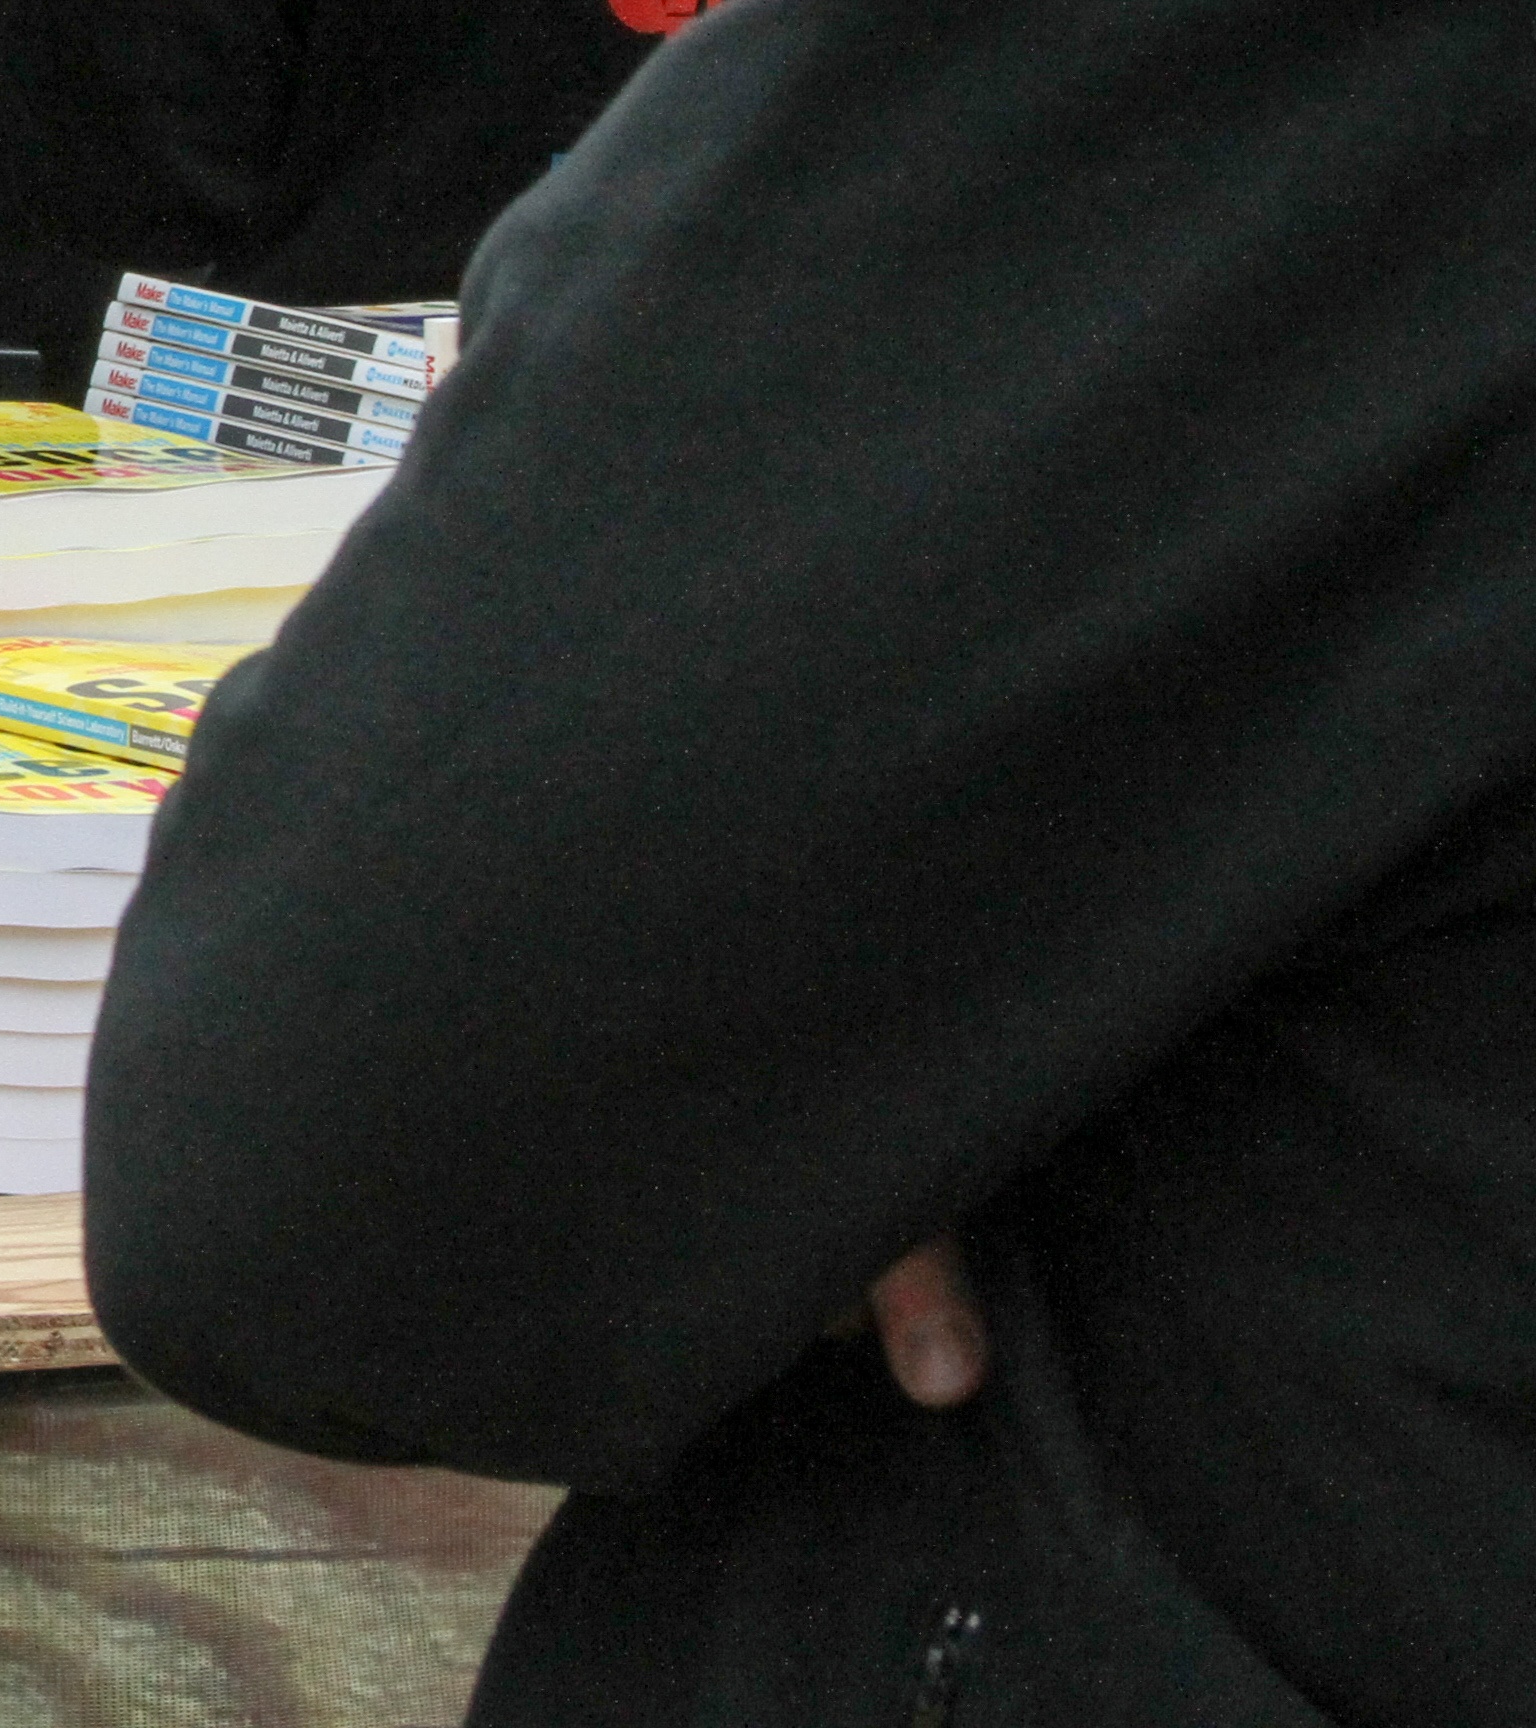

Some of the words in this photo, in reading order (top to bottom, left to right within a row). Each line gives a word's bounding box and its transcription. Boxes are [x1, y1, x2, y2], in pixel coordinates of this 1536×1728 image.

[136, 280, 164, 303] Make:
[121, 309, 149, 331] Make:
[116, 339, 144, 362] Make:
[108, 367, 136, 390] Make:
[102, 396, 129, 418] Make:
[132, 727, 186, 757] Barrett/Oska
